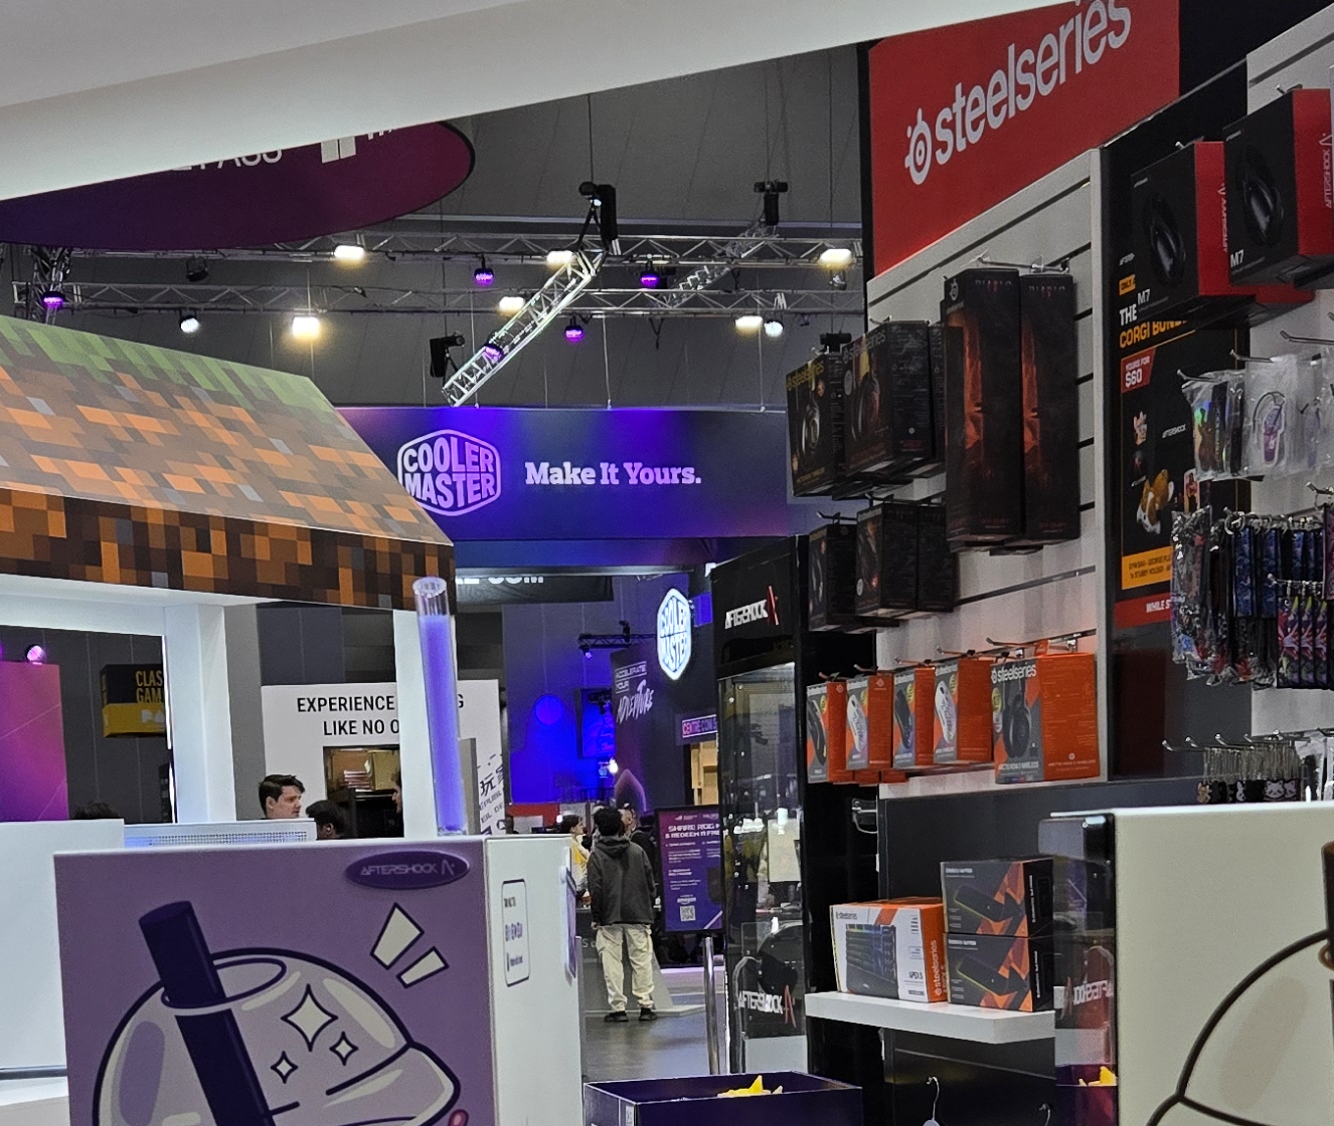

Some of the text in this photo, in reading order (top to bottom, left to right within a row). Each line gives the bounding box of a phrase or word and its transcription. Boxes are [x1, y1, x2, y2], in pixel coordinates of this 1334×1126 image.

[935, 0, 1132, 165] steelseries
[1229, 249, 1245, 268] M7
[1137, 288, 1151, 306] M7
[1119, 303, 1138, 327] THE
[1119, 321, 1151, 349] CORGI
[1125, 368, 1143, 389] $60
[403, 437, 495, 473] COOLER
[524, 461, 702, 486] Make It Yours.
[404, 471, 496, 509] MASTER
[135, 670, 163, 687] CLAS
[998, 663, 1037, 682] steelseries
[297, 694, 396, 713] EXPERIENCE
[323, 719, 358, 737] LIKE
[363, 719, 385, 735] NO
[360, 863, 439, 877] AFTERSHOCK
